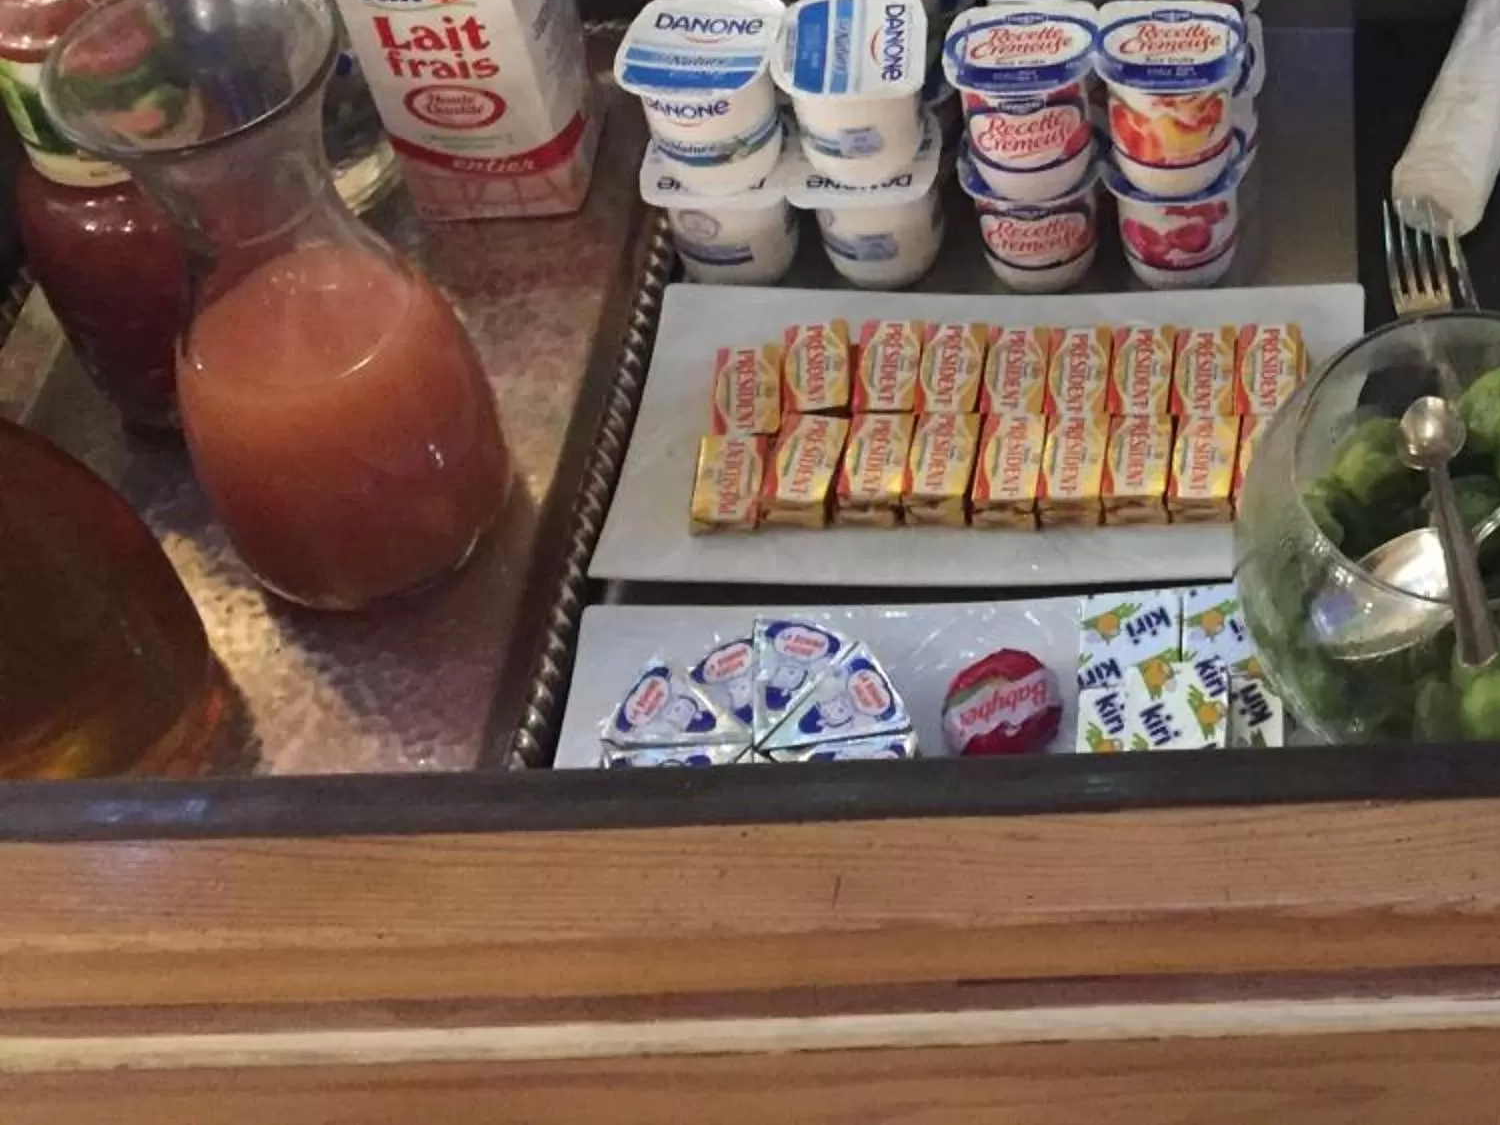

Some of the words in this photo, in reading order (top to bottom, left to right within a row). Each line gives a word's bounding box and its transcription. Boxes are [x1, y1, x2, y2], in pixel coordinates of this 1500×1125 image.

[373, 16, 491, 52] Lait
[387, 49, 500, 80] frais
[1125, 606, 1172, 646] kiri
[1195, 658, 1229, 698] kiri
[1095, 692, 1126, 735] kiri
[1138, 703, 1181, 746] kiri
